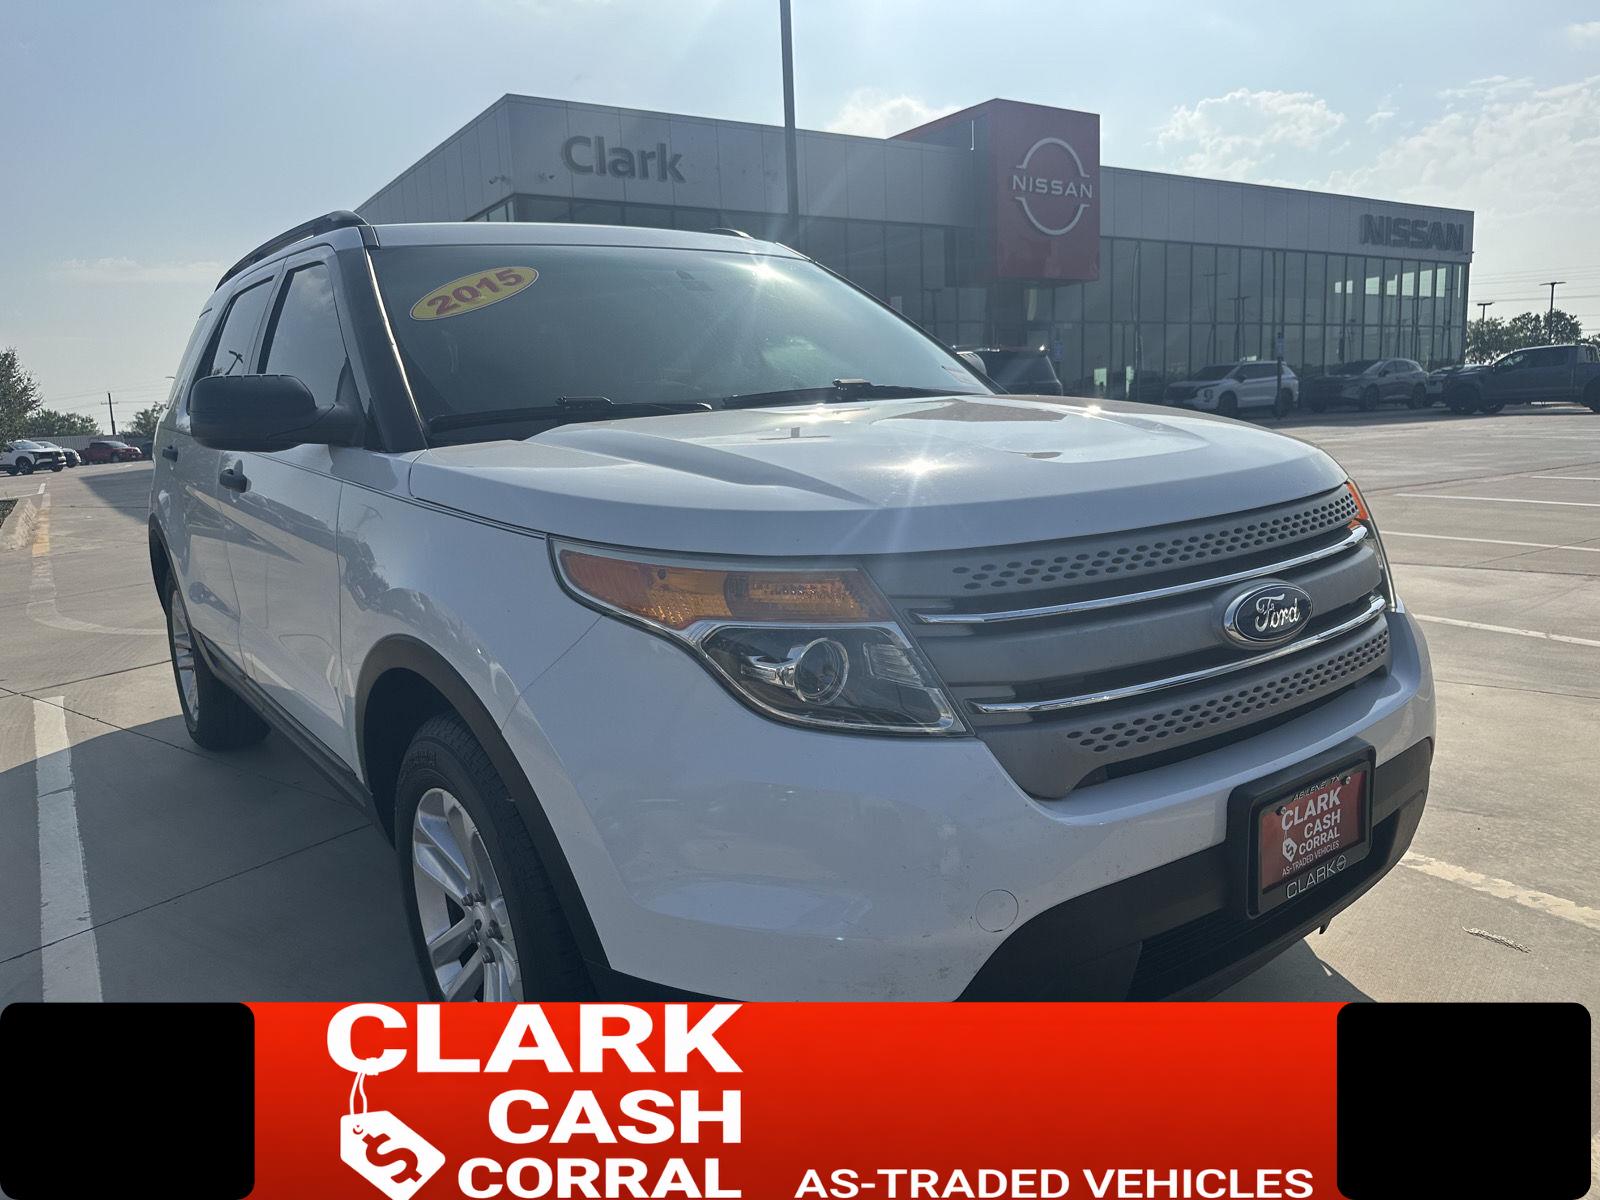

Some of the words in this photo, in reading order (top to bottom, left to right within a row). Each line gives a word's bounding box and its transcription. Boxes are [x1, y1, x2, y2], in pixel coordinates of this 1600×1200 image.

[561, 135, 686, 183] Clark
[1012, 174, 1093, 199] NISSAN
[1360, 214, 1465, 251] NISSAN
[427, 268, 524, 315] 2015
[1255, 593, 1300, 632] Ford
[1281, 786, 1342, 831] CLARK
[1304, 809, 1341, 838] CASH
[1282, 853, 1314, 877] AS-TRADED
[1314, 840, 1341, 859] VEHICLES
[1298, 827, 1341, 855] CORRAL
[1286, 860, 1336, 899] CLARK
